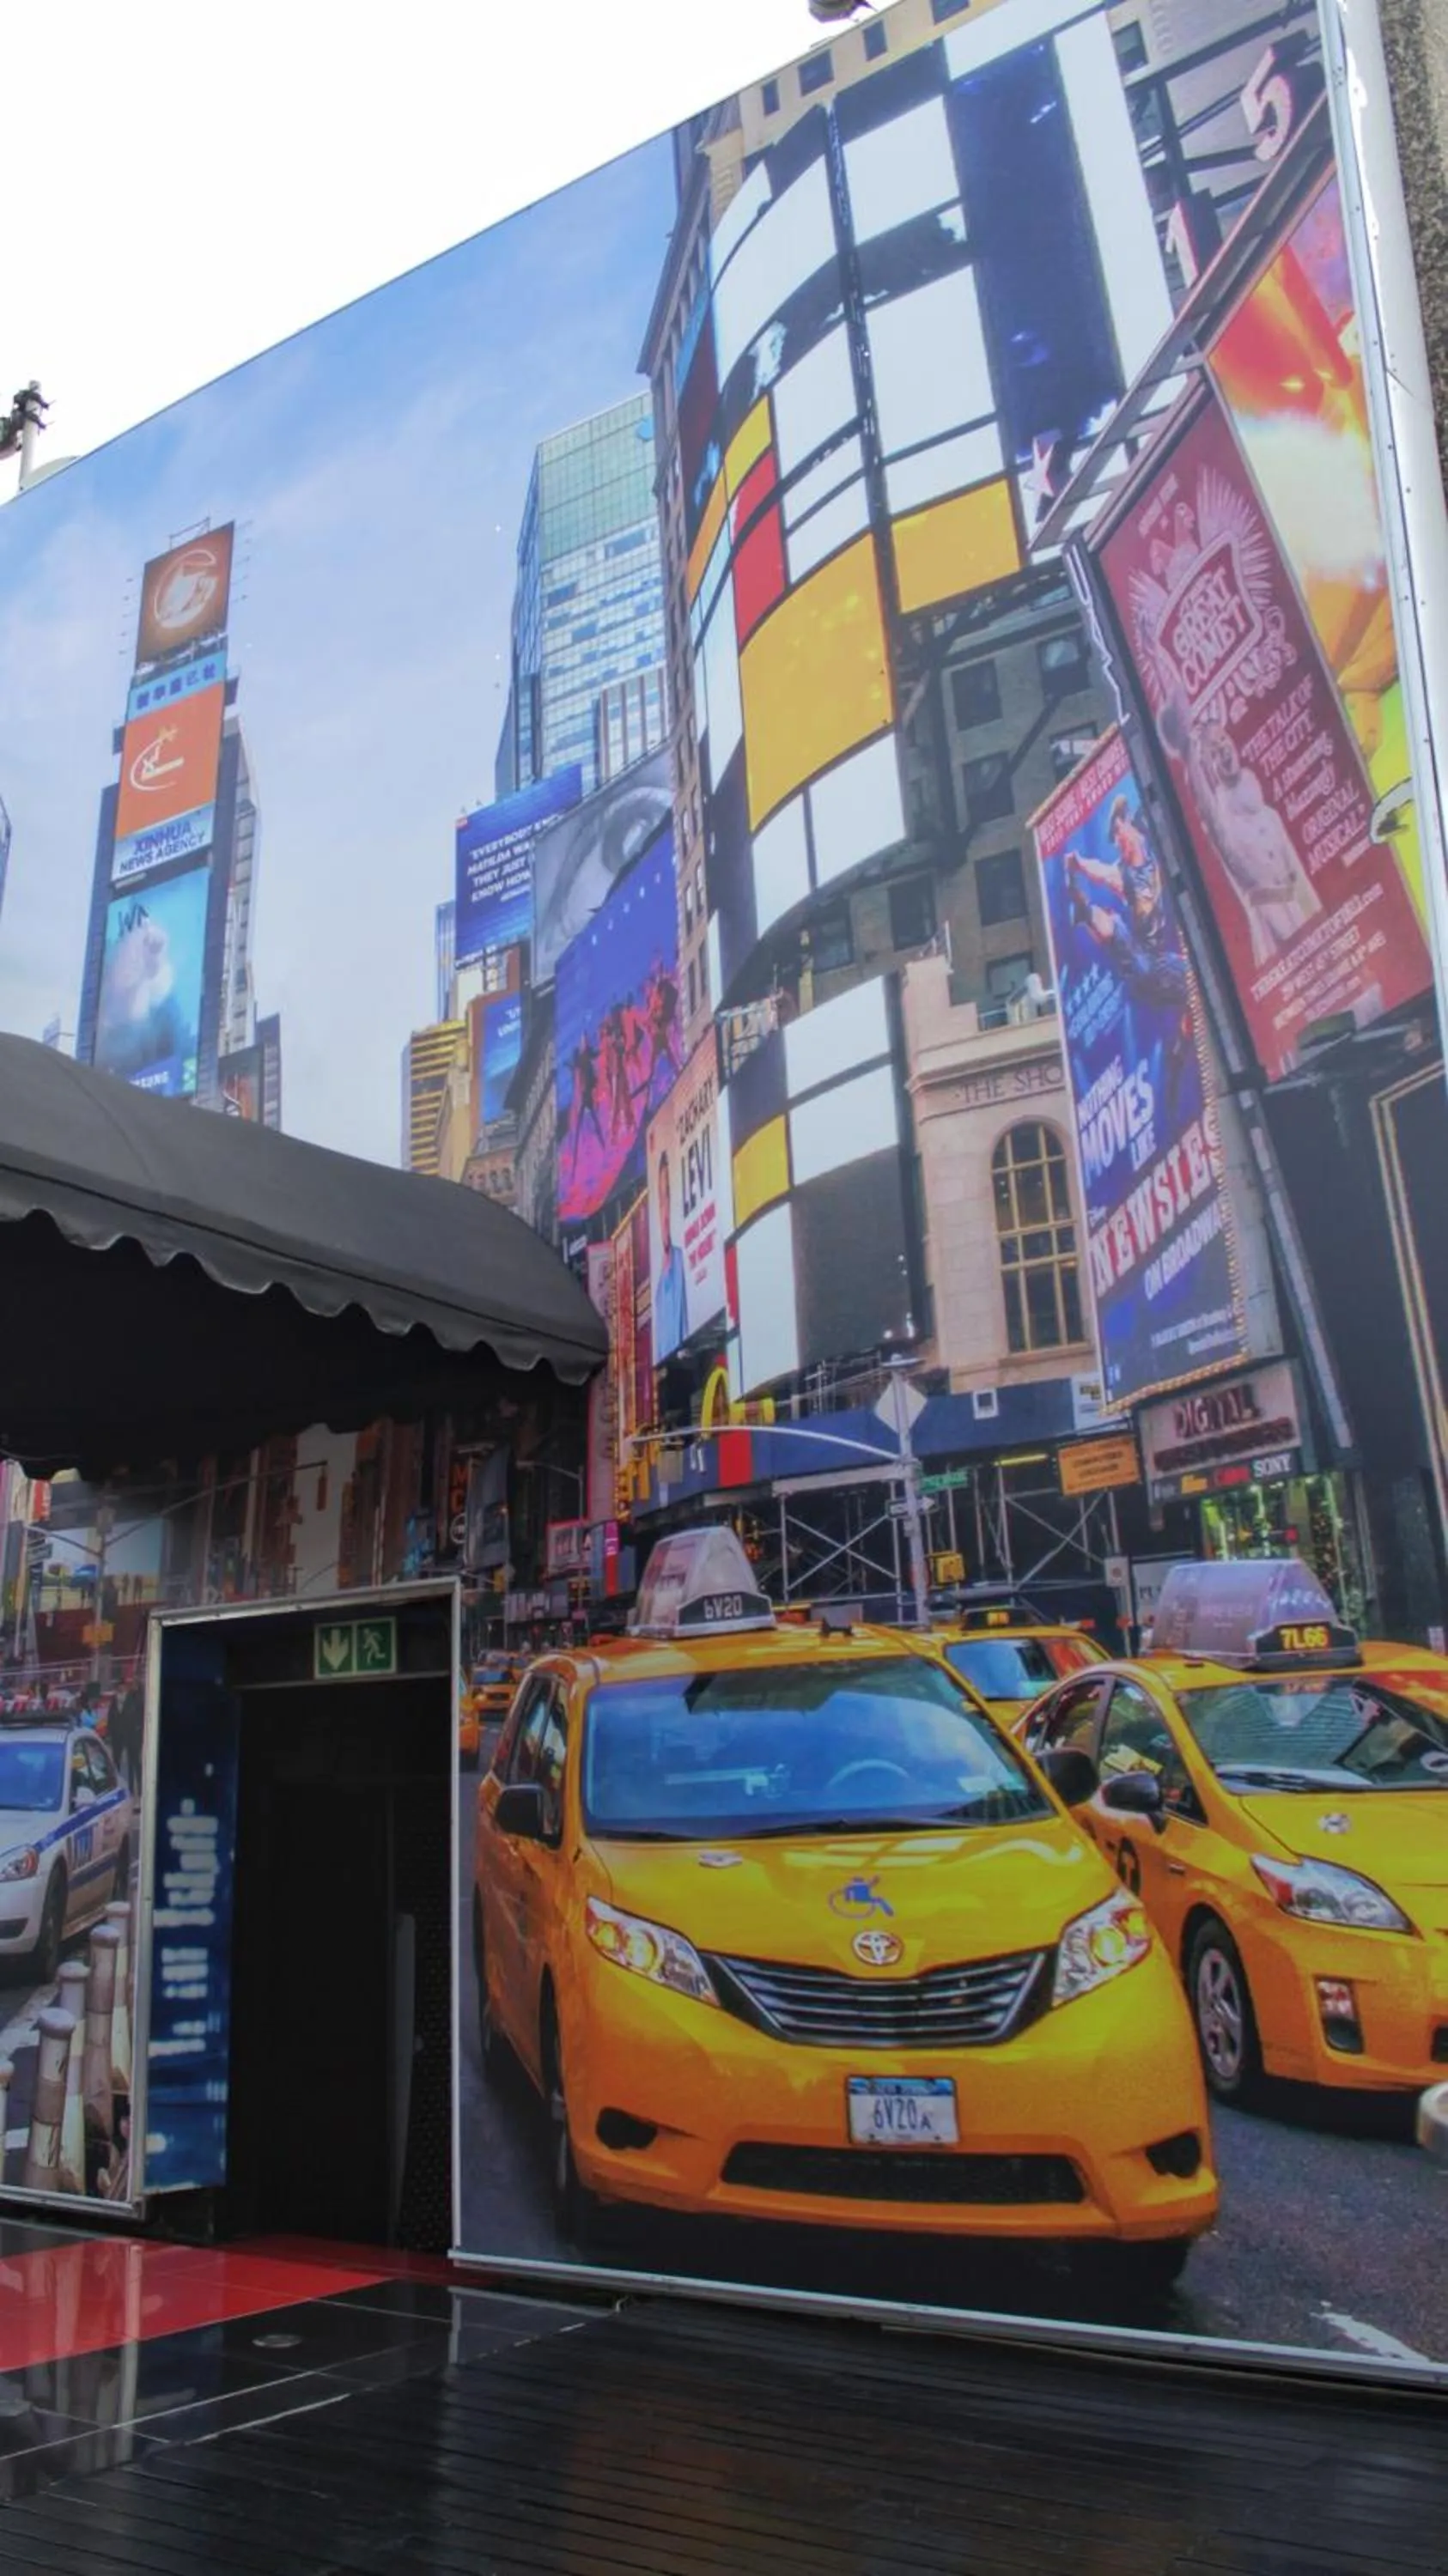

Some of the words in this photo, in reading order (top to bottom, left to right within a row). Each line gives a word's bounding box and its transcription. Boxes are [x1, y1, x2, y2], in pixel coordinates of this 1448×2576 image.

[119, 850, 154, 874] NEWS
[155, 830, 207, 859] AGENCY
[133, 820, 192, 856] XINHUA
[960, 1078, 1006, 1104] THE
[1014, 1063, 1064, 1093] SHO
[1080, 1057, 1155, 1190] MOVES
[680, 1122, 714, 1219] LEVI
[1144, 1259, 1164, 1302] ON
[1159, 1201, 1224, 1285] BROADWA
[1253, 1453, 1292, 1479] SONY
[703, 1595, 744, 1620] 6V20
